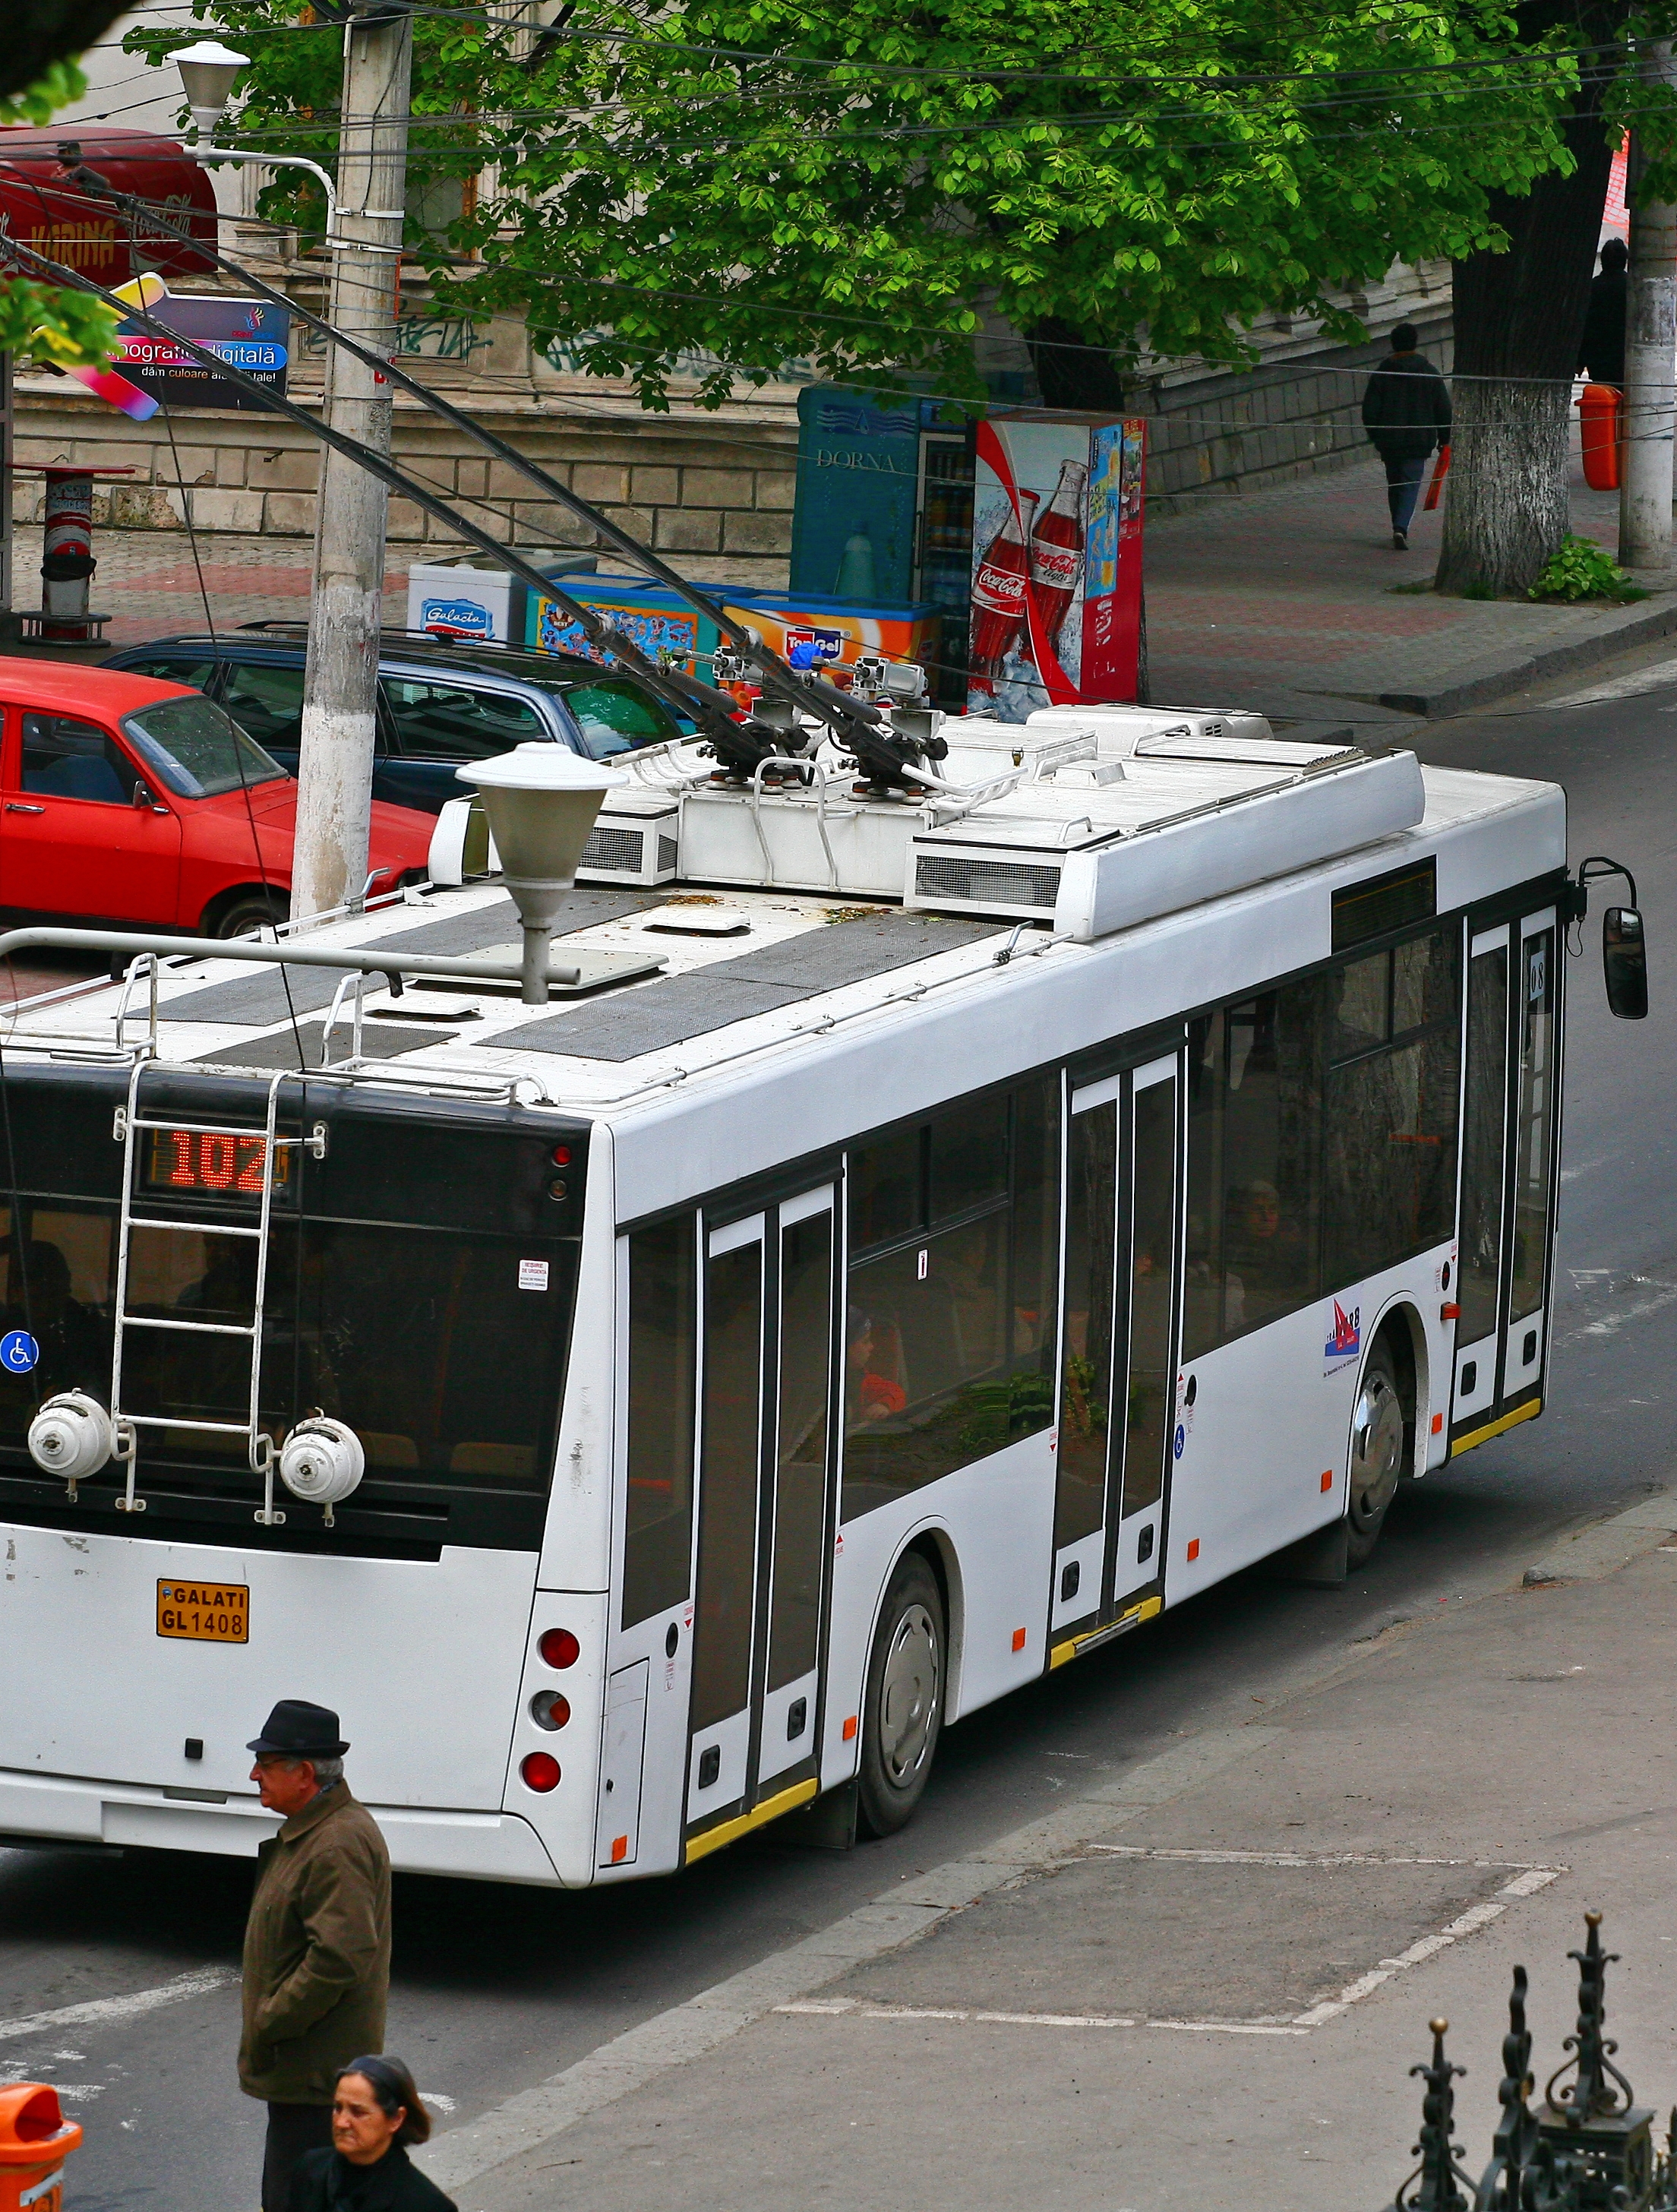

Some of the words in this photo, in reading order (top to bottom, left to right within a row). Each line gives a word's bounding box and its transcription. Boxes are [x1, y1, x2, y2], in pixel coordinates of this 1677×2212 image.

[169, 369, 208, 379] culoare
[816, 449, 895, 472] DORNA
[428, 608, 485, 621] Galacta
[788, 637, 811, 648] To
[815, 639, 838, 652] Gel
[171, 1131, 267, 1191] 102
[174, 1588, 244, 1608] GALATI
[162, 1610, 187, 1630] GL
[191, 1612, 242, 1635] 1408
